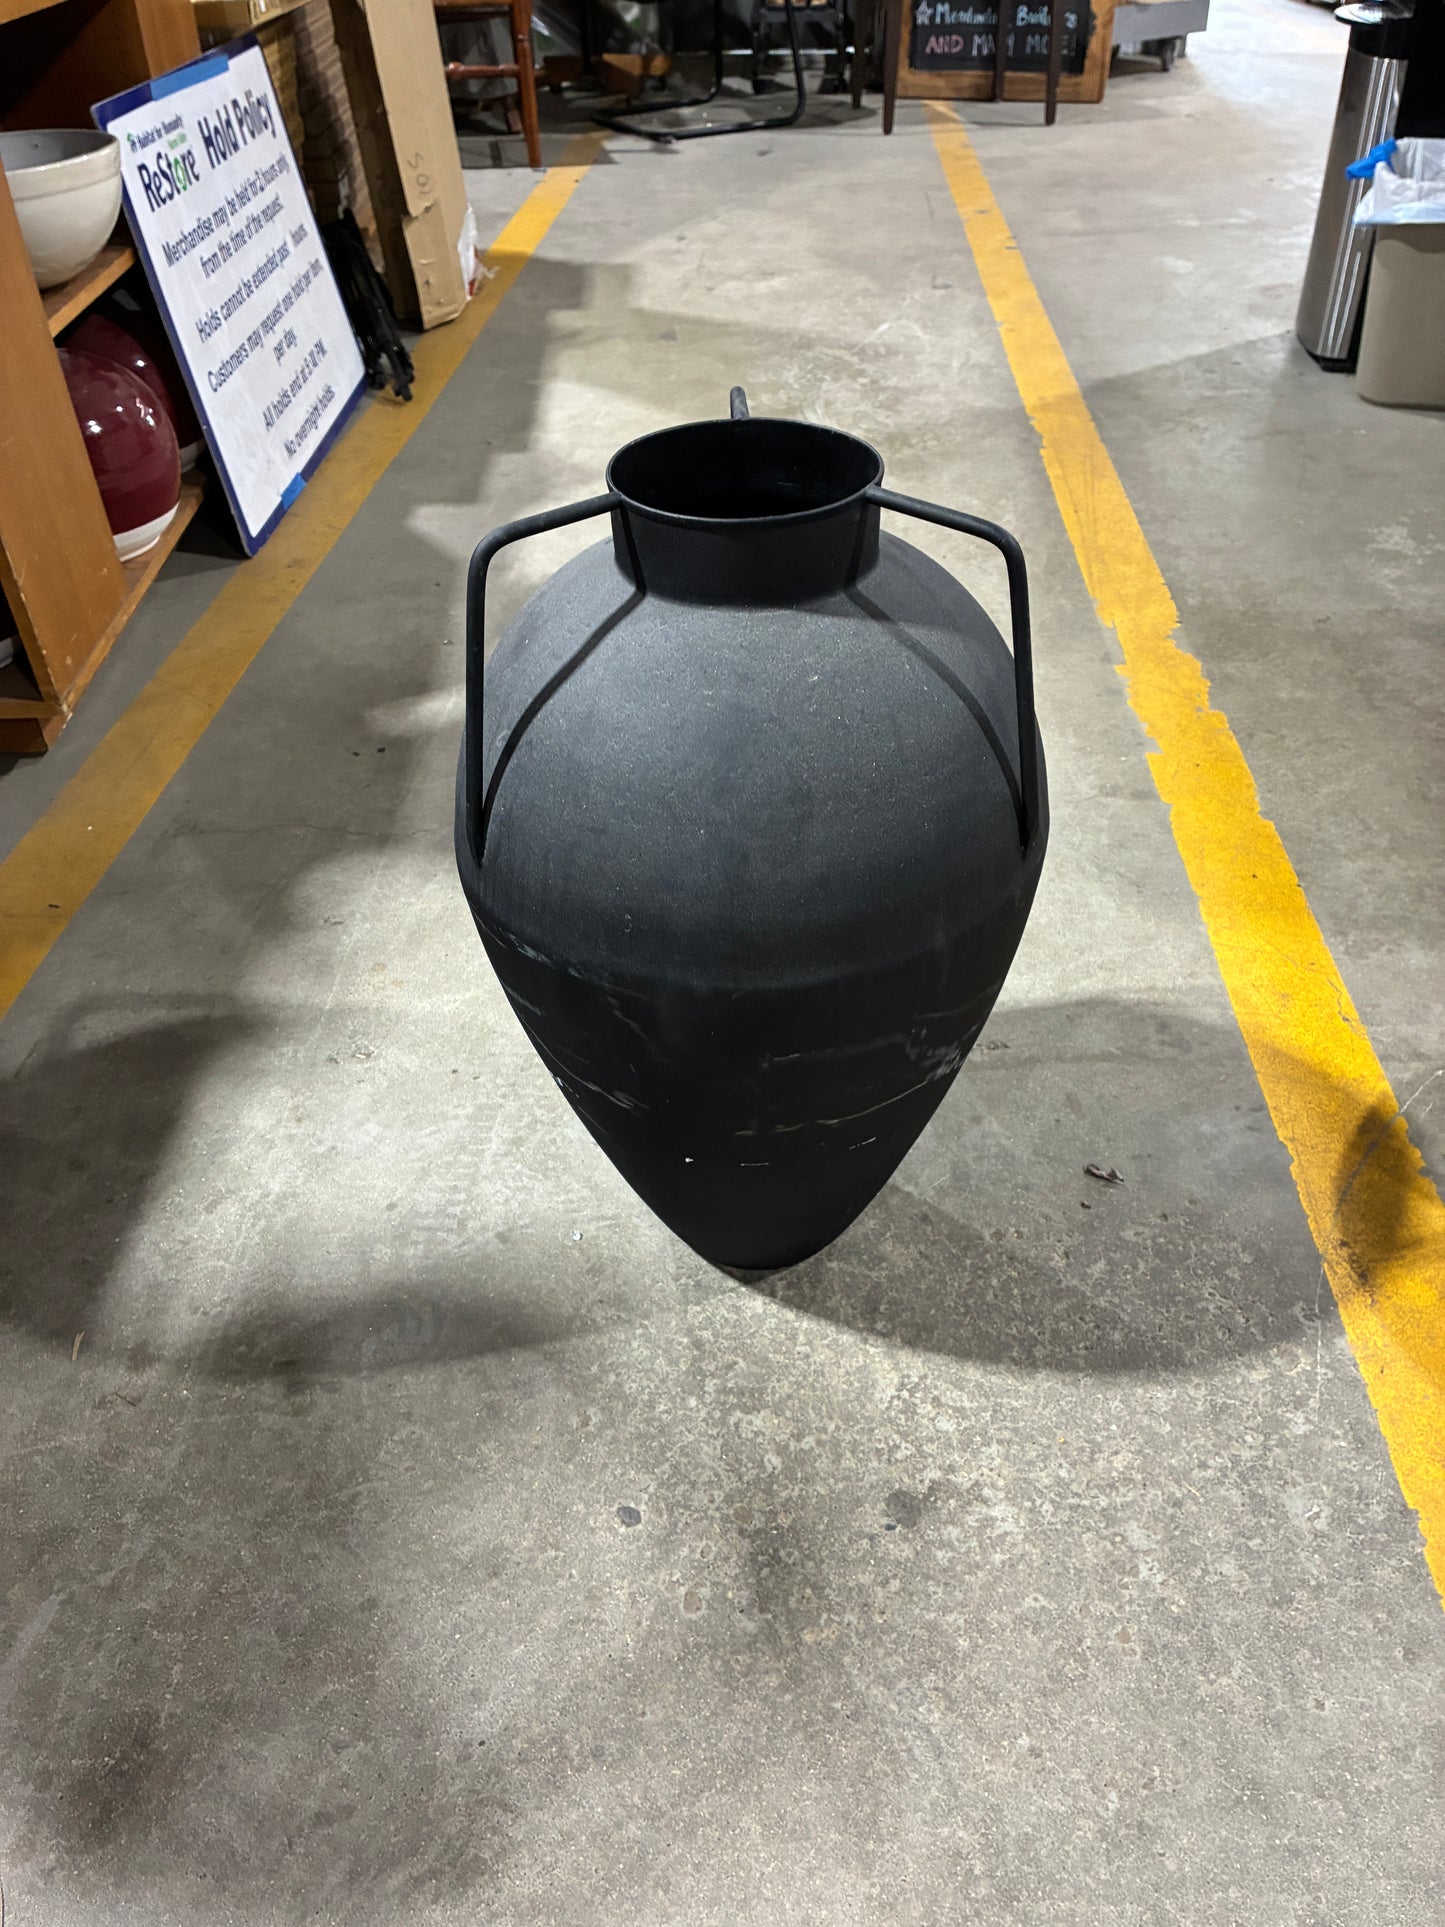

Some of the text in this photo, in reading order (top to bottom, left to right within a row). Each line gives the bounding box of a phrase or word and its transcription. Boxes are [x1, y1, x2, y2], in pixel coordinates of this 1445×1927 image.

[925, 34, 964, 55] AND
[972, 32, 1015, 57] MAY
[198, 90, 276, 169] Hold Policy
[137, 149, 199, 212] ReStore
[162, 217, 214, 266] Merchandise
[212, 206, 229, 230] may
[225, 197, 238, 216] be
[200, 252, 221, 278] from
[218, 241, 233, 263] the
[229, 229, 247, 252] time
[245, 217, 253, 239] of
[251, 214, 263, 233] the
[196, 309, 221, 343] Holds
[220, 285, 246, 320] cannot
[241, 279, 254, 298] be
[252, 253, 279, 289] extended
[208, 343, 249, 392] Customers
[246, 327, 263, 354] may
[260, 302, 284, 336] request
[263, 406, 275, 431] All
[272, 389, 291, 419] holds
[289, 375, 302, 397] end
